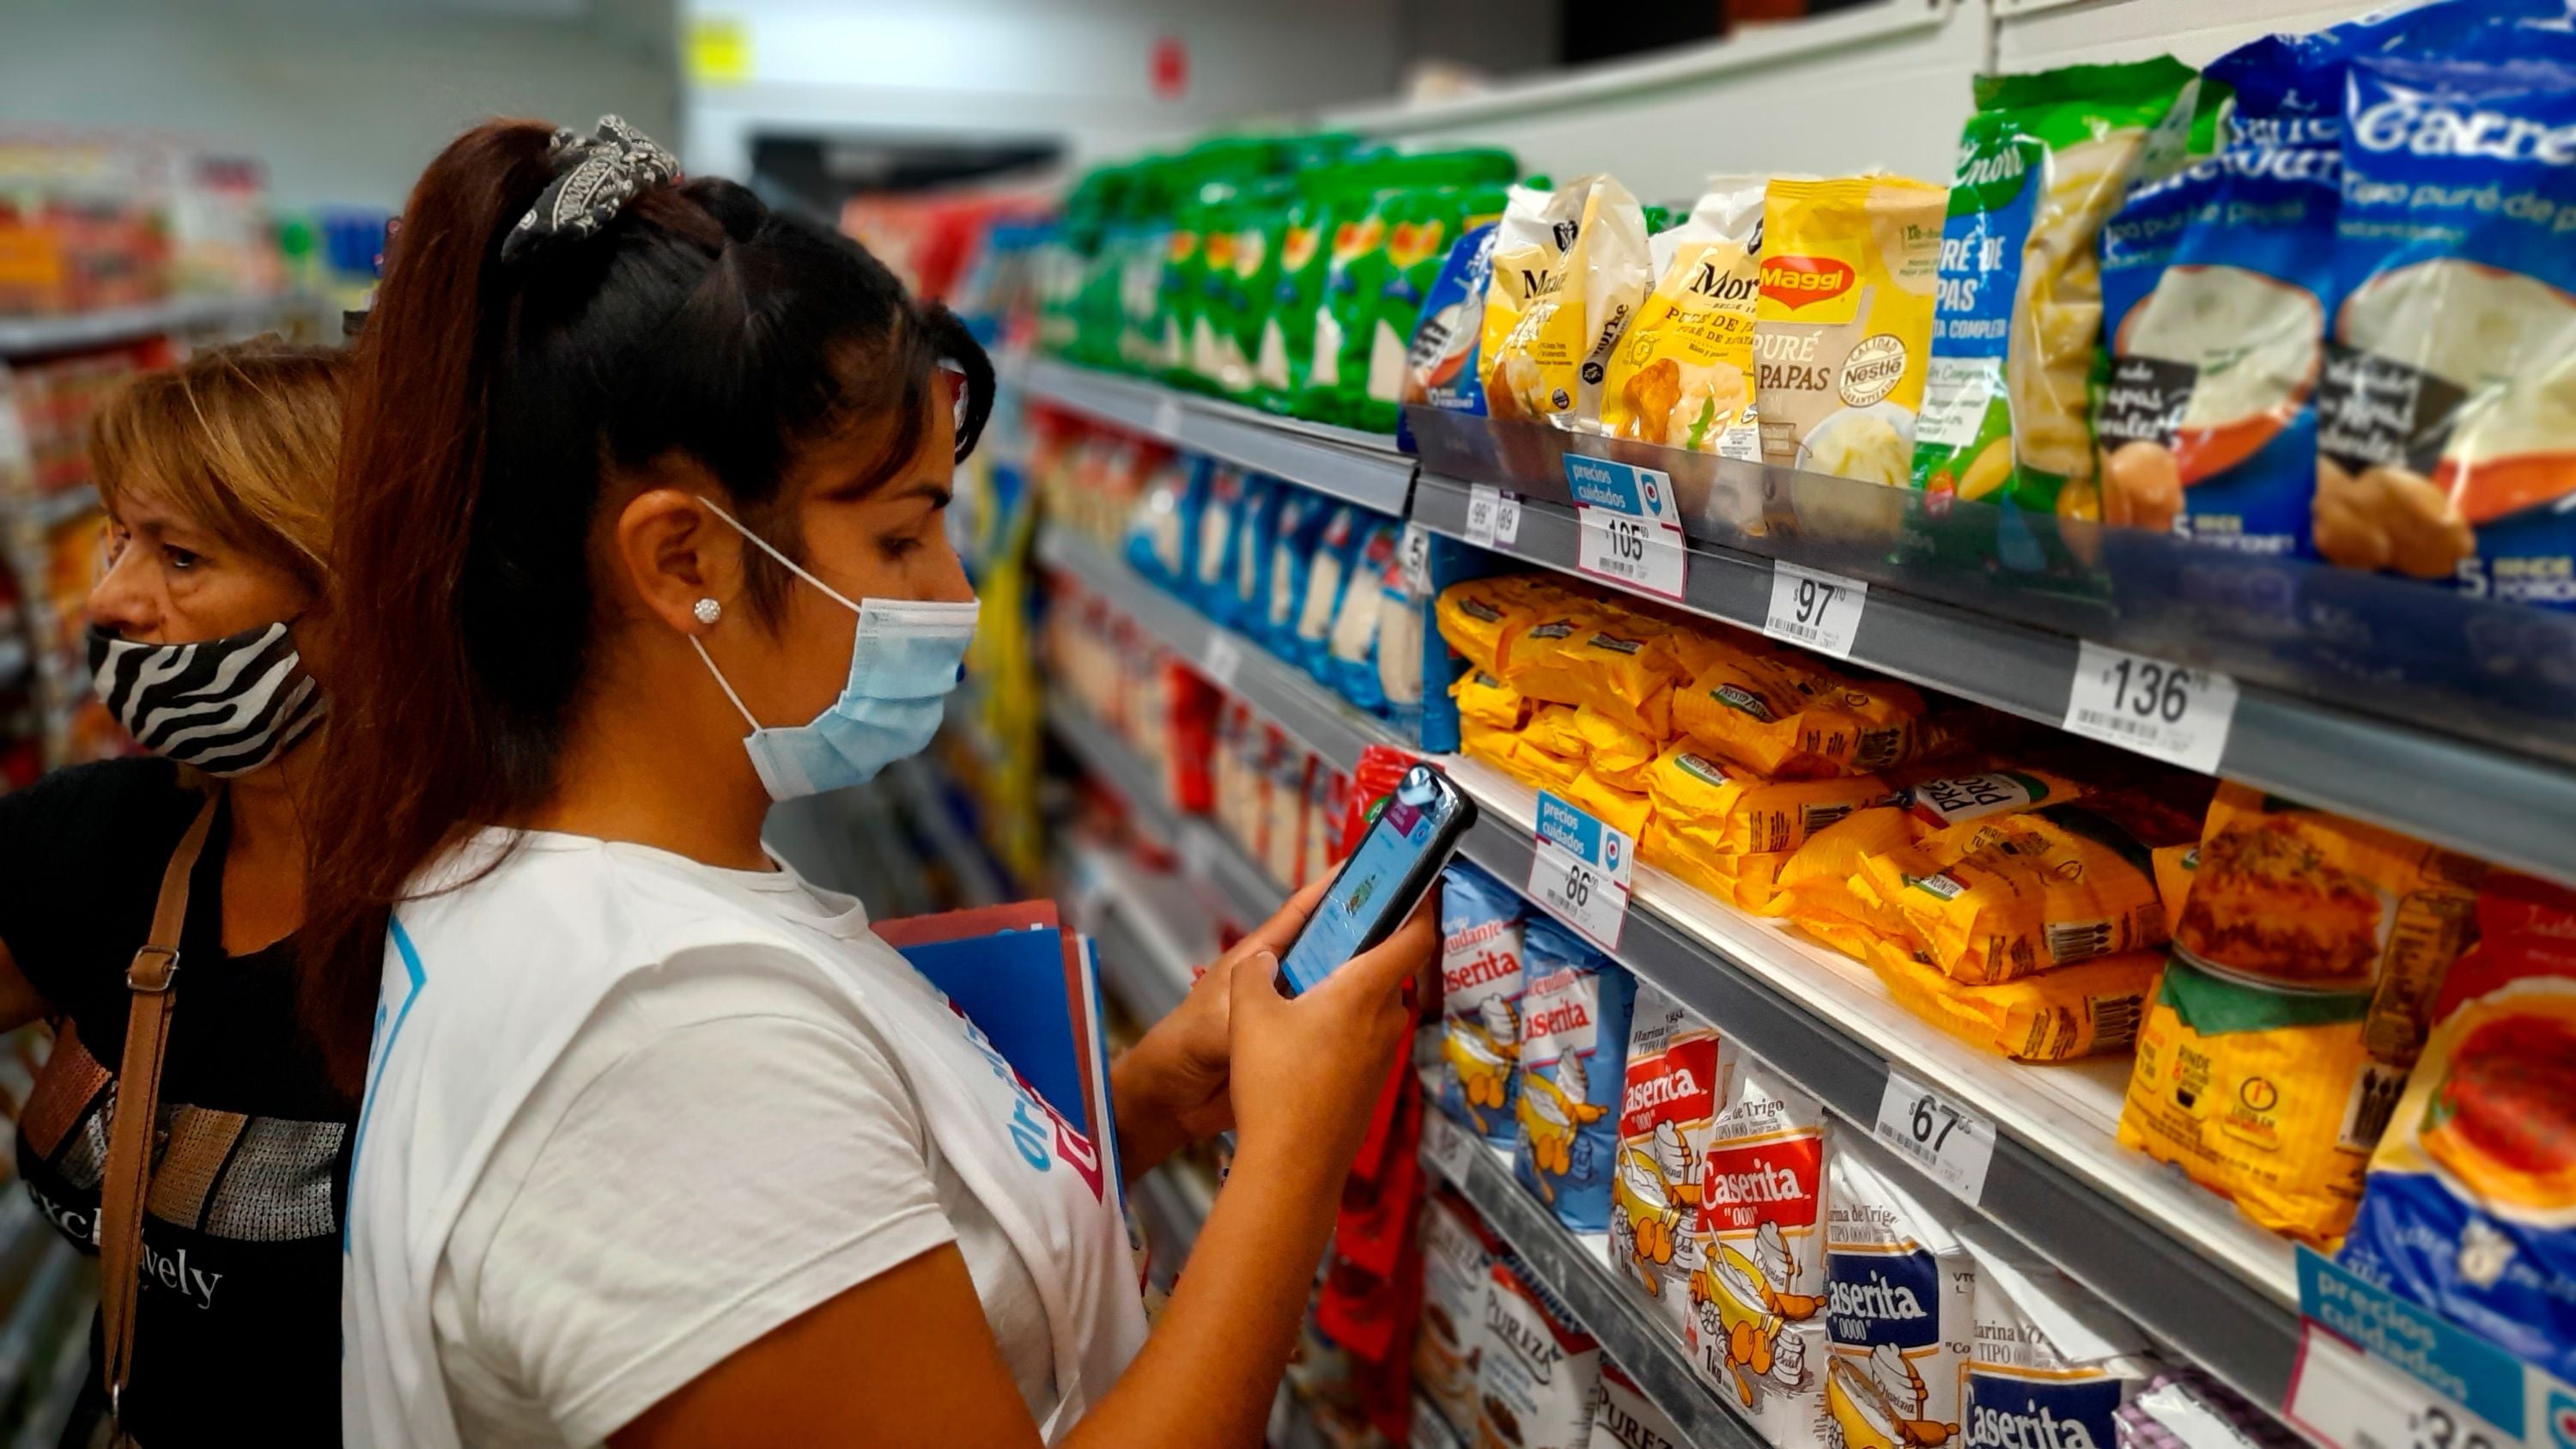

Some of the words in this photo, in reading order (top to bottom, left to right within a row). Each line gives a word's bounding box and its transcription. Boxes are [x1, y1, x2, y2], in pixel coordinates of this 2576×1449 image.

[1940, 232, 1975, 272] RÉ
[1689, 261, 1759, 302] Mor
[1760, 269, 1844, 290] Maggi
[1711, 314, 1739, 332] DE
[1706, 331, 1723, 343] DE
[1759, 364, 1831, 391] PAPAS
[1572, 461, 1611, 485] precios
[1578, 484, 1626, 508] cuidados
[1544, 801, 1579, 831] precios
[1542, 821, 1585, 855] cuidados
[1522, 997, 1591, 1045] aserita
[1633, 1026, 1666, 1045] Harina
[1733, 1107, 1743, 1120] de
[1743, 1098, 1784, 1117] Trigo
[1701, 1158, 1803, 1210] Caserita
[1851, 1203, 1863, 1221] de
[1826, 1269, 1928, 1320] aserita
[1978, 1342, 2012, 1363] TIPO
[2319, 1303, 2468, 1405] cuidados
[1964, 1383, 2100, 1449] Caserita
